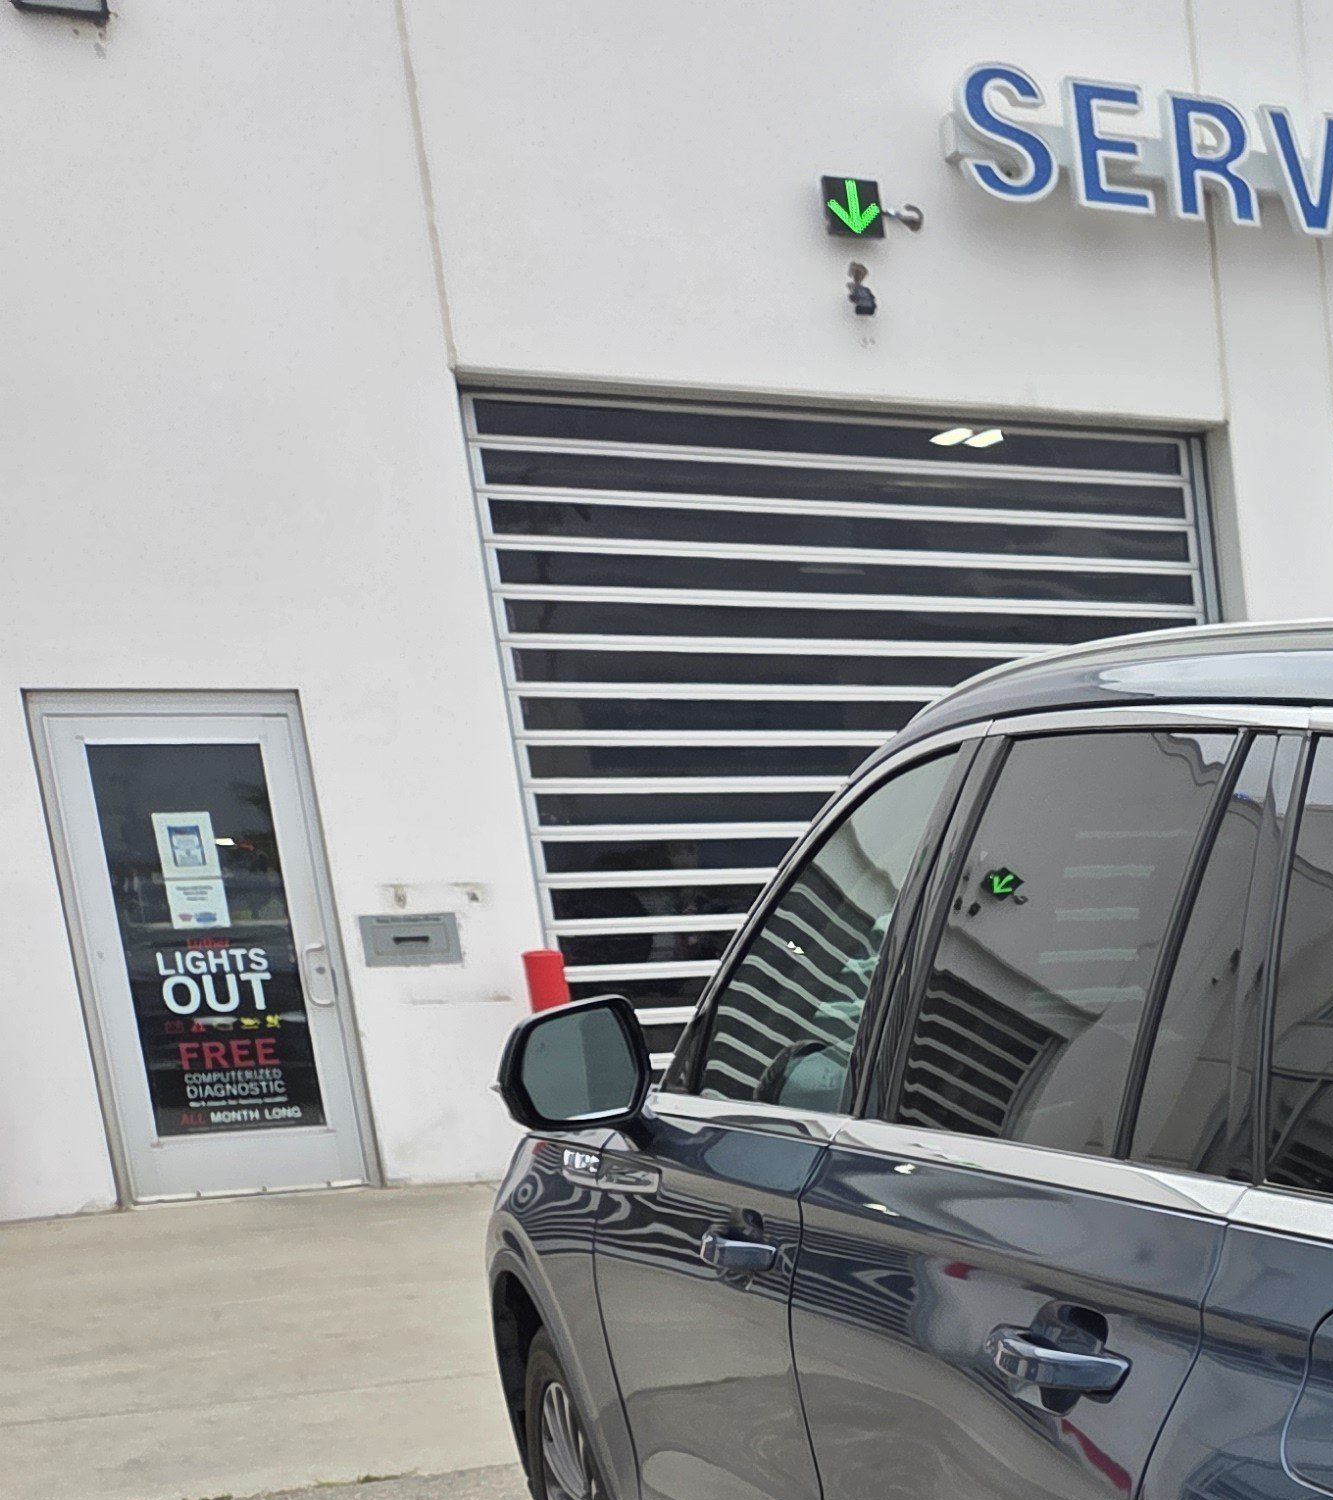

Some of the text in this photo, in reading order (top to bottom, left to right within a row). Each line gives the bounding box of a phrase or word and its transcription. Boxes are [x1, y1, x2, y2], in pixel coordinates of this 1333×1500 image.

[155, 948, 269, 976] LIGHTS
[162, 972, 272, 1015] OUT
[178, 1037, 281, 1070] FREE
[184, 1068, 282, 1085] COMPUTERIZED
[186, 1081, 287, 1099] DIAGNOSTIC
[210, 1109, 260, 1124] MONTH
[264, 1105, 302, 1120] LONG
